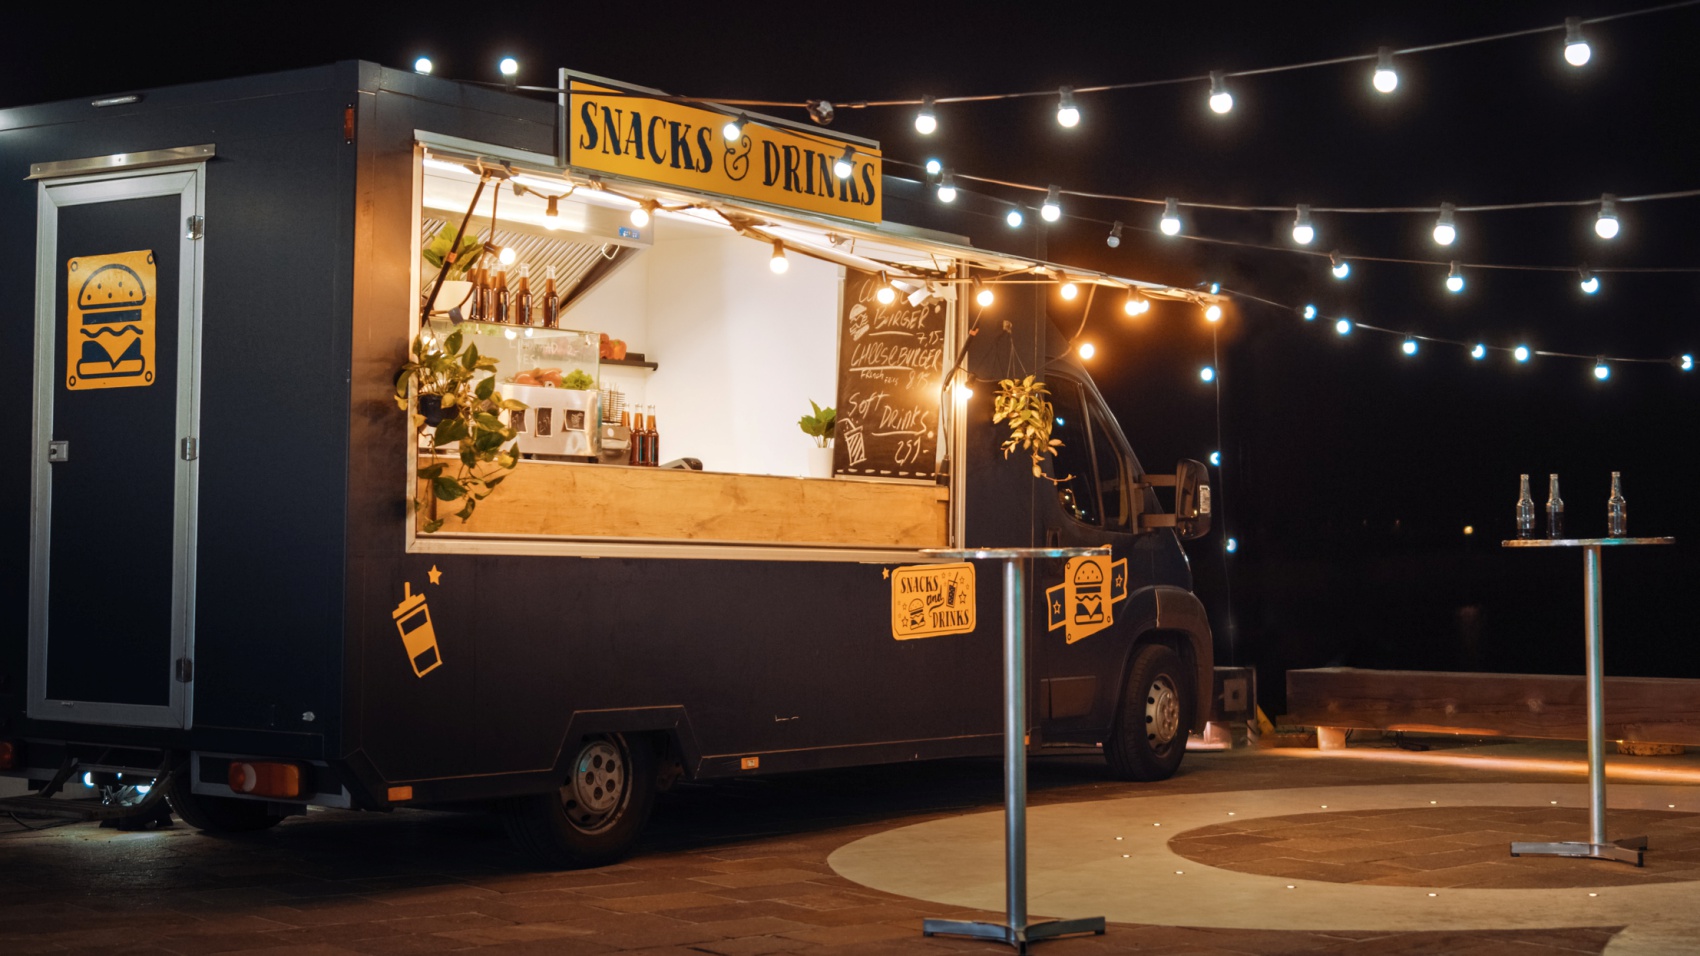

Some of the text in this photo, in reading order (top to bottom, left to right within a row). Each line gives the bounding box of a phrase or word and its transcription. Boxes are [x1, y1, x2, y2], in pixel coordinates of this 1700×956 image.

[580, 101, 876, 206] SNACKS & DRINKS
[901, 575, 938, 594] SNACKS
[926, 584, 945, 608] and
[932, 609, 969, 628] DRINKS
